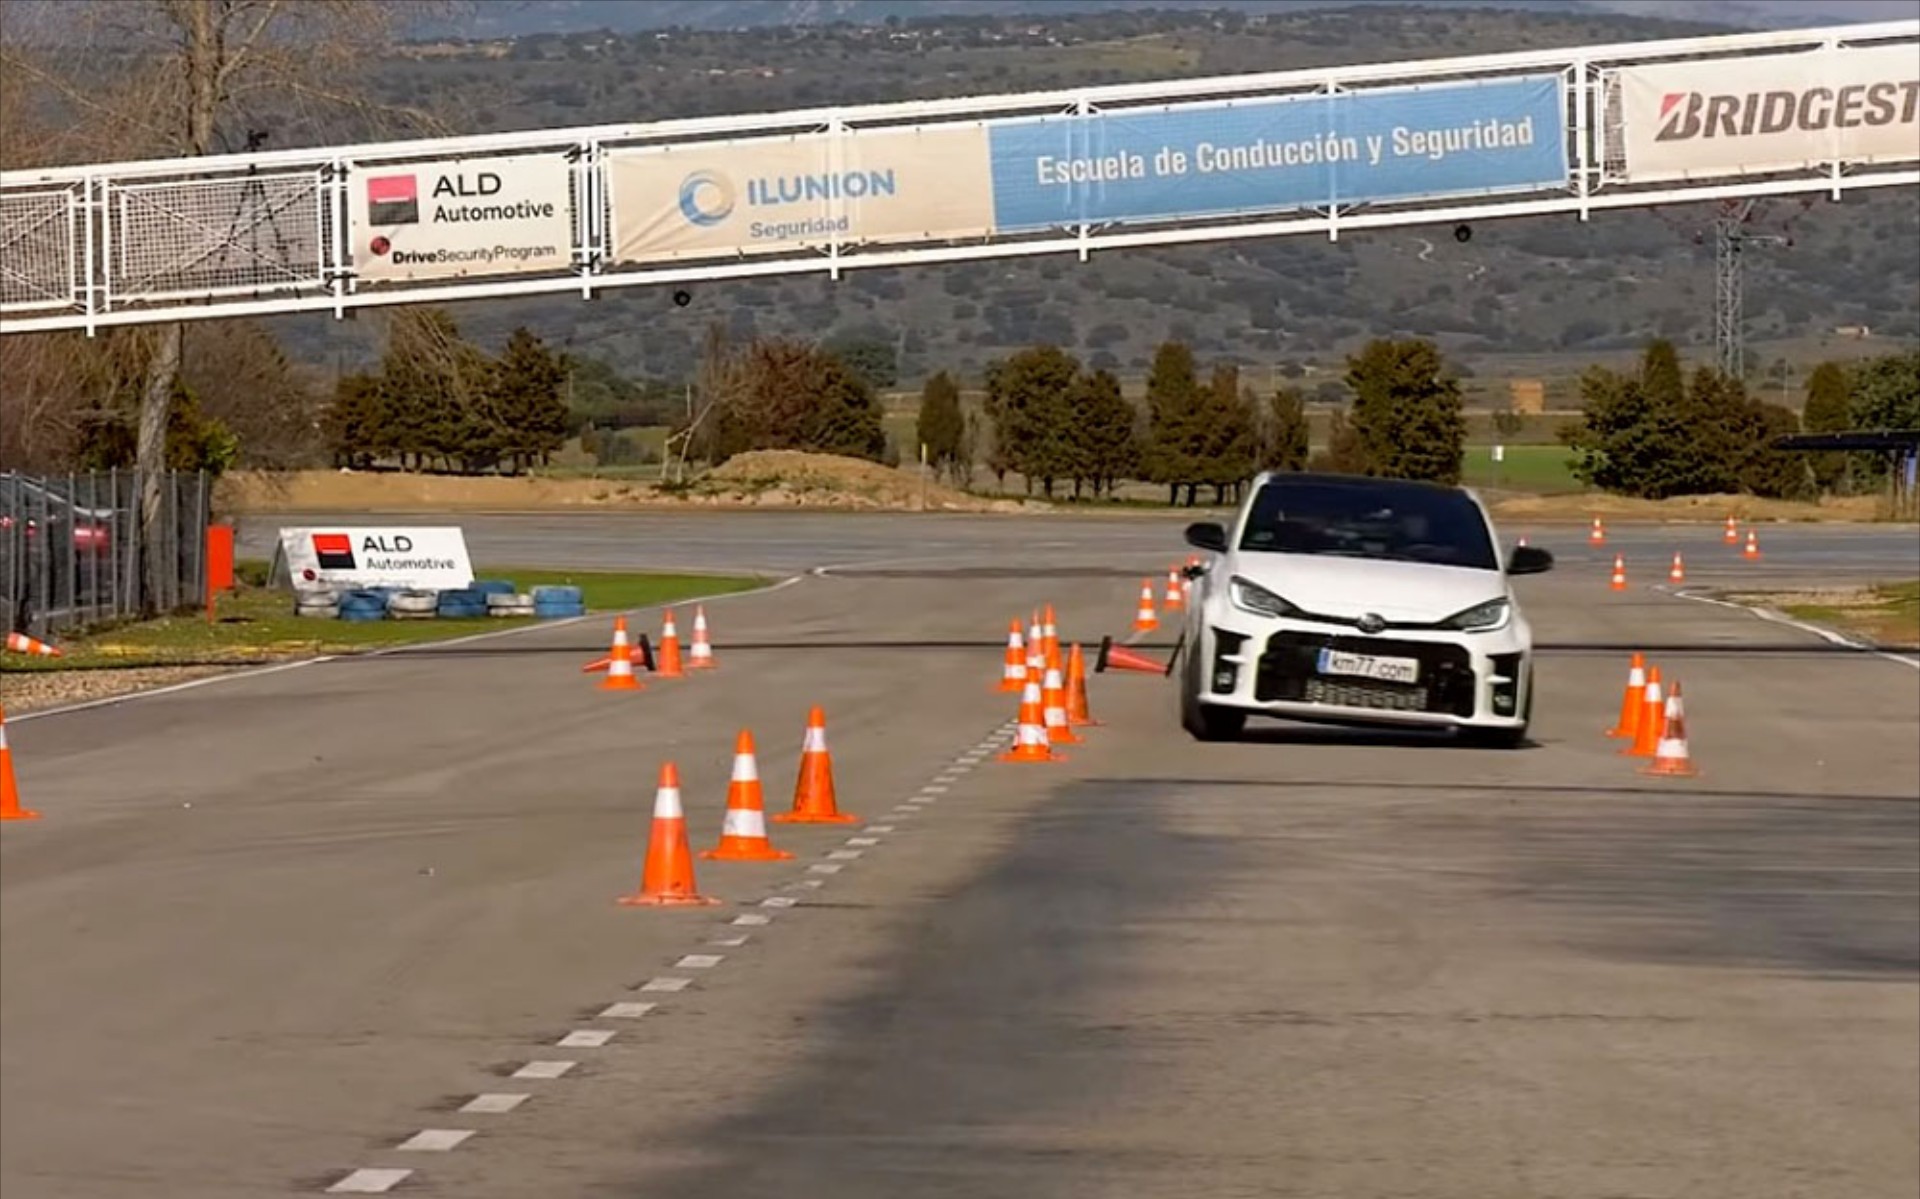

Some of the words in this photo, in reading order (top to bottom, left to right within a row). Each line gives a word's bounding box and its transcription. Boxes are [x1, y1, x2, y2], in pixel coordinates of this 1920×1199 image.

[1655, 81, 1919, 142] BRIDGEST
[1037, 150, 1145, 185] Escuela
[1155, 145, 1187, 176] de
[1197, 130, 1358, 172] Conducción
[1368, 133, 1384, 166] y
[1393, 116, 1533, 161] Seguridad
[432, 172, 502, 198] ALD
[747, 169, 896, 205] ILUNION
[433, 199, 554, 223] Automotive
[750, 215, 850, 240] Seguridad
[392, 245, 556, 265] DriveSecurityProgram
[362, 535, 413, 553] ALD
[366, 557, 456, 571] Automotive
[1332, 654, 1413, 680] km77.com
